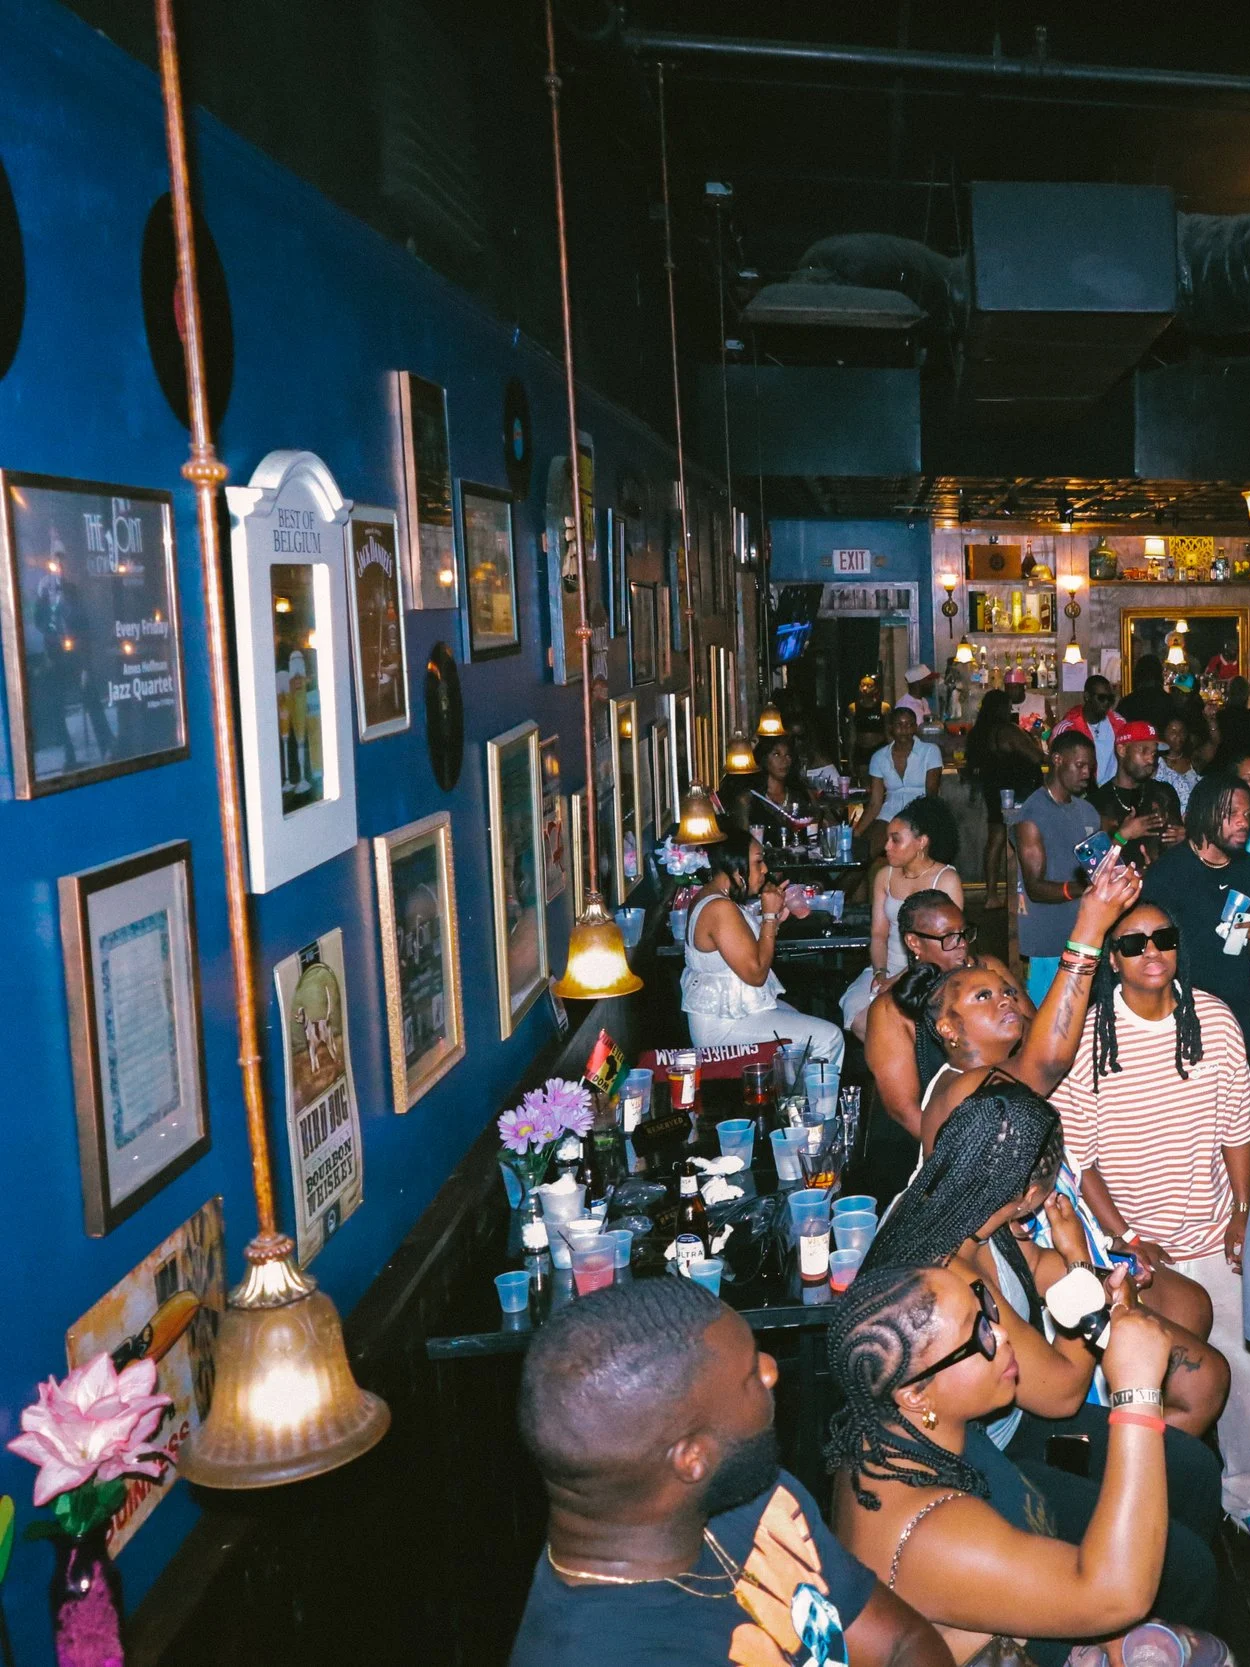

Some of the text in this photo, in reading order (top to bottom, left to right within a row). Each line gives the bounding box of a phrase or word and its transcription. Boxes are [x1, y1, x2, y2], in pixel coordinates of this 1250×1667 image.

[278, 508, 315, 529] BEST OF
[273, 529, 322, 554] BELGIUM
[840, 551, 866, 570] EXIT
[115, 619, 168, 640] Every Friday
[107, 681, 131, 707] Jazz
[133, 675, 173, 700] Quartet
[299, 1083, 349, 1160] BIRD DOG
[305, 1137, 352, 1195] BOURBON
[306, 1153, 352, 1217] WHISKEY
[1113, 1391, 1133, 1404] VIP
